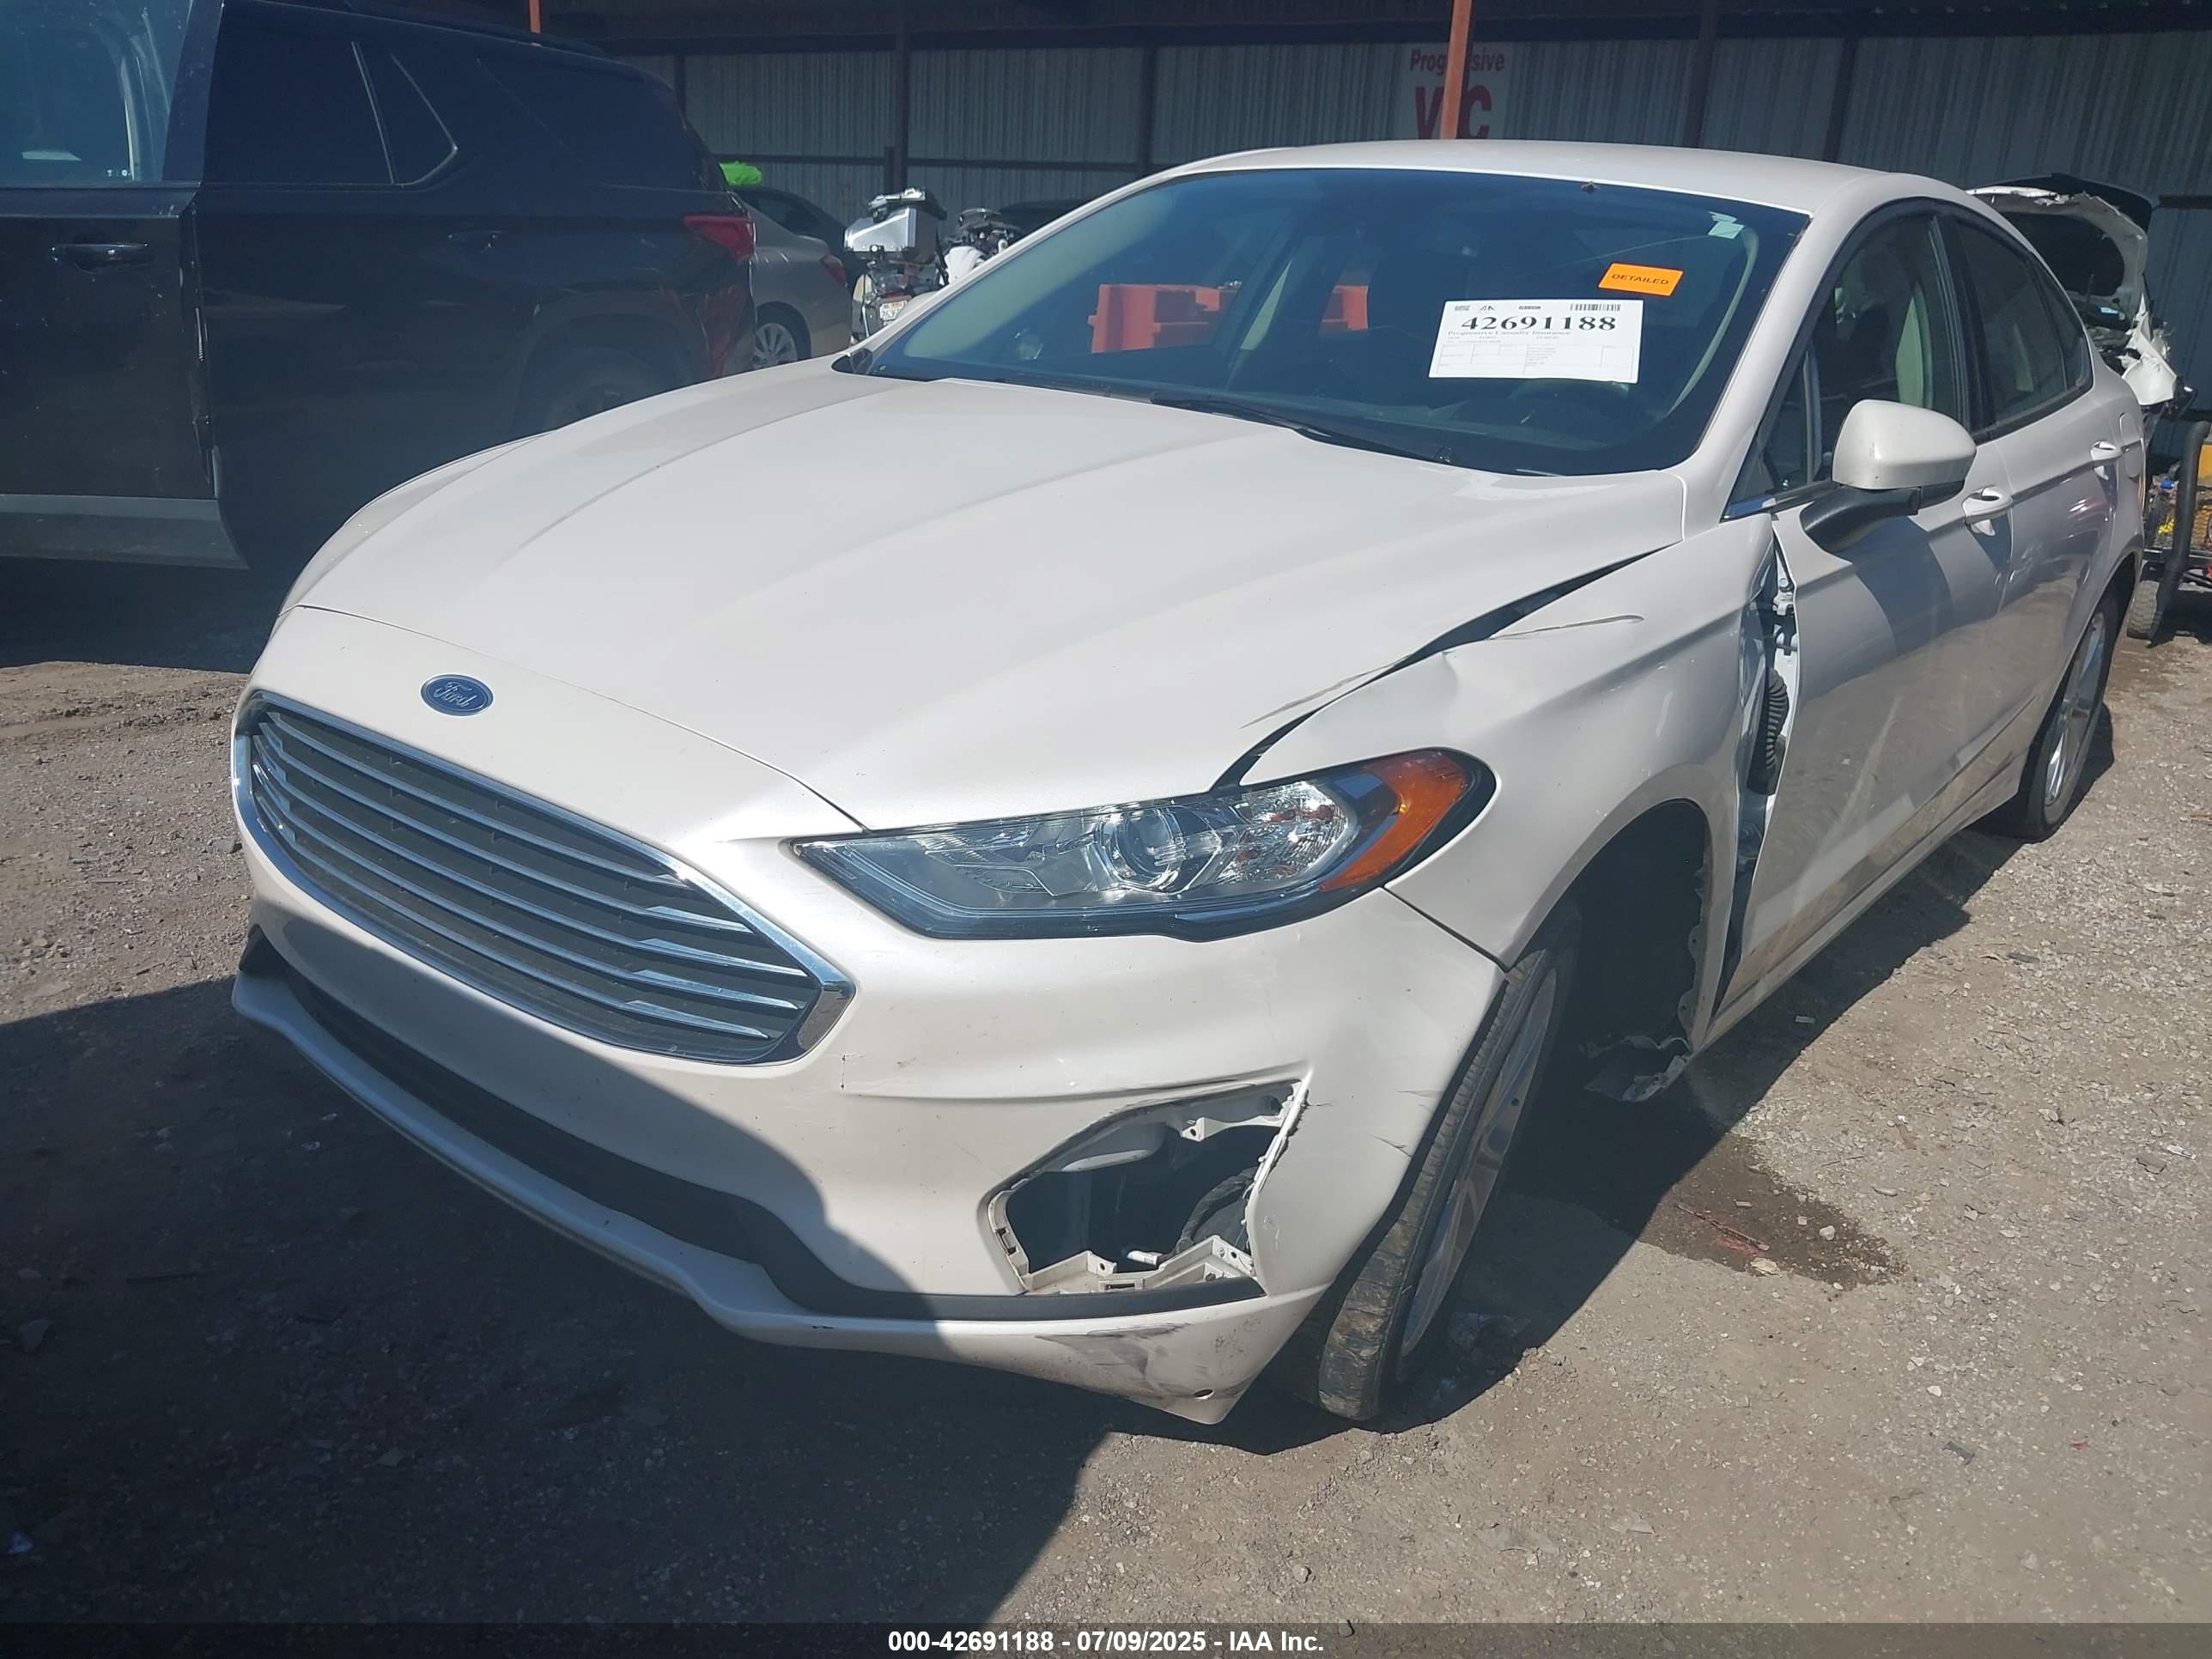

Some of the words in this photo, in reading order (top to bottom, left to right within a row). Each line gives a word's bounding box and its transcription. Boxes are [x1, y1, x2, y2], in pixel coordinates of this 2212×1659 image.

[1409, 48, 1504, 76] Progsive
[1415, 85, 1492, 139] VC
[1611, 274, 1669, 285] DETAILED
[1461, 316, 1616, 331] 42691188
[433, 681, 478, 707] Ford
